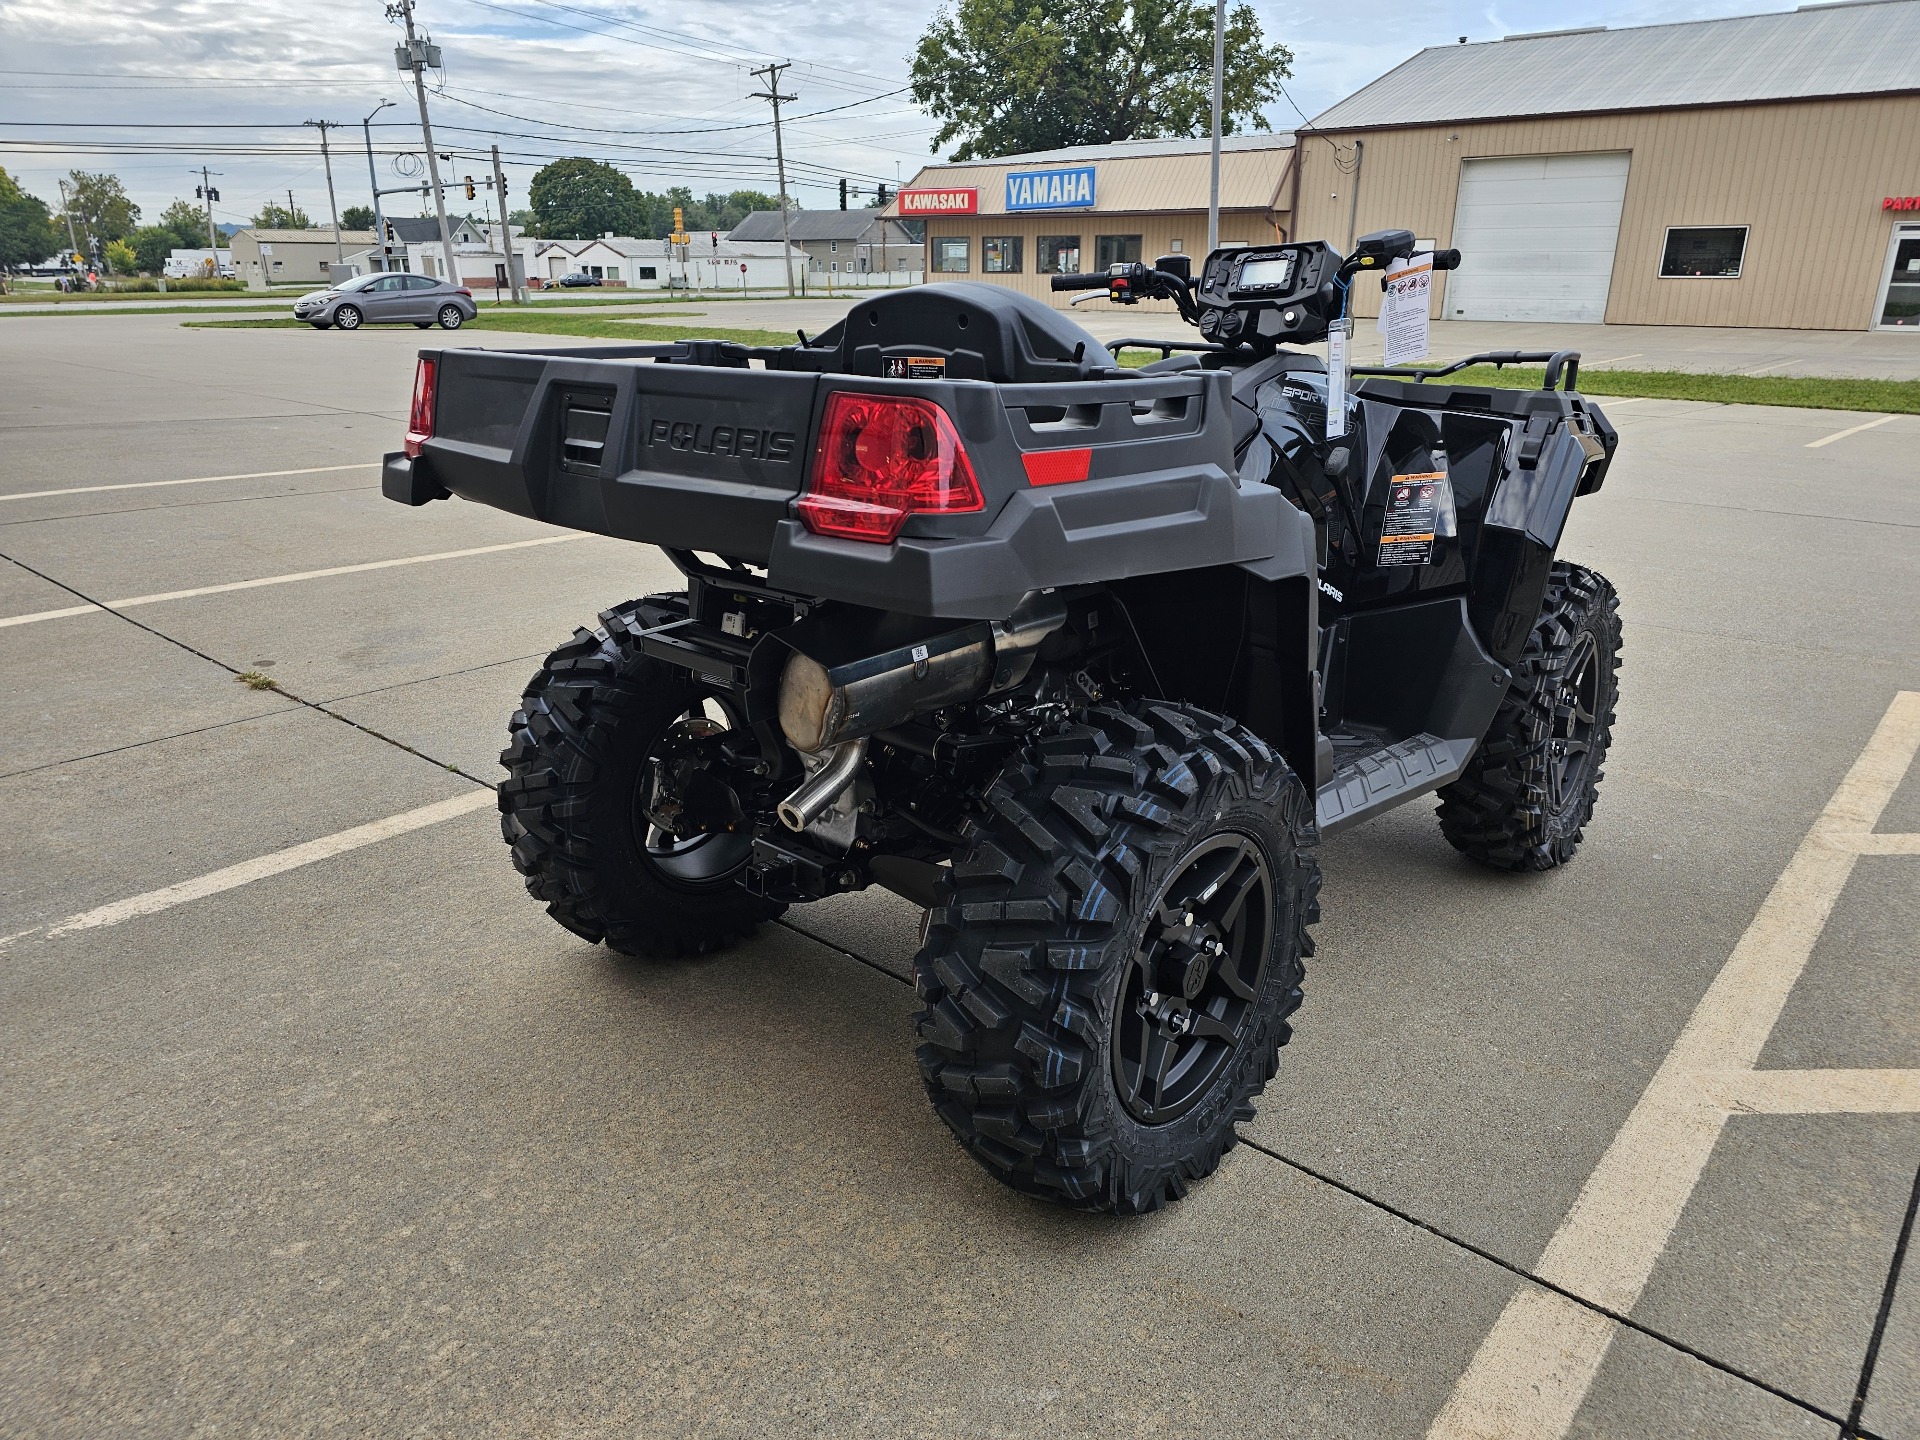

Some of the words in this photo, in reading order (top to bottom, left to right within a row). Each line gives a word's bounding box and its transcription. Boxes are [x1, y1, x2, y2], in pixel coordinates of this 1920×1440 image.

[904, 193, 969, 210] KAWASAKI
[1008, 172, 1091, 205] YAMAHA
[648, 419, 796, 464] POLARIS
